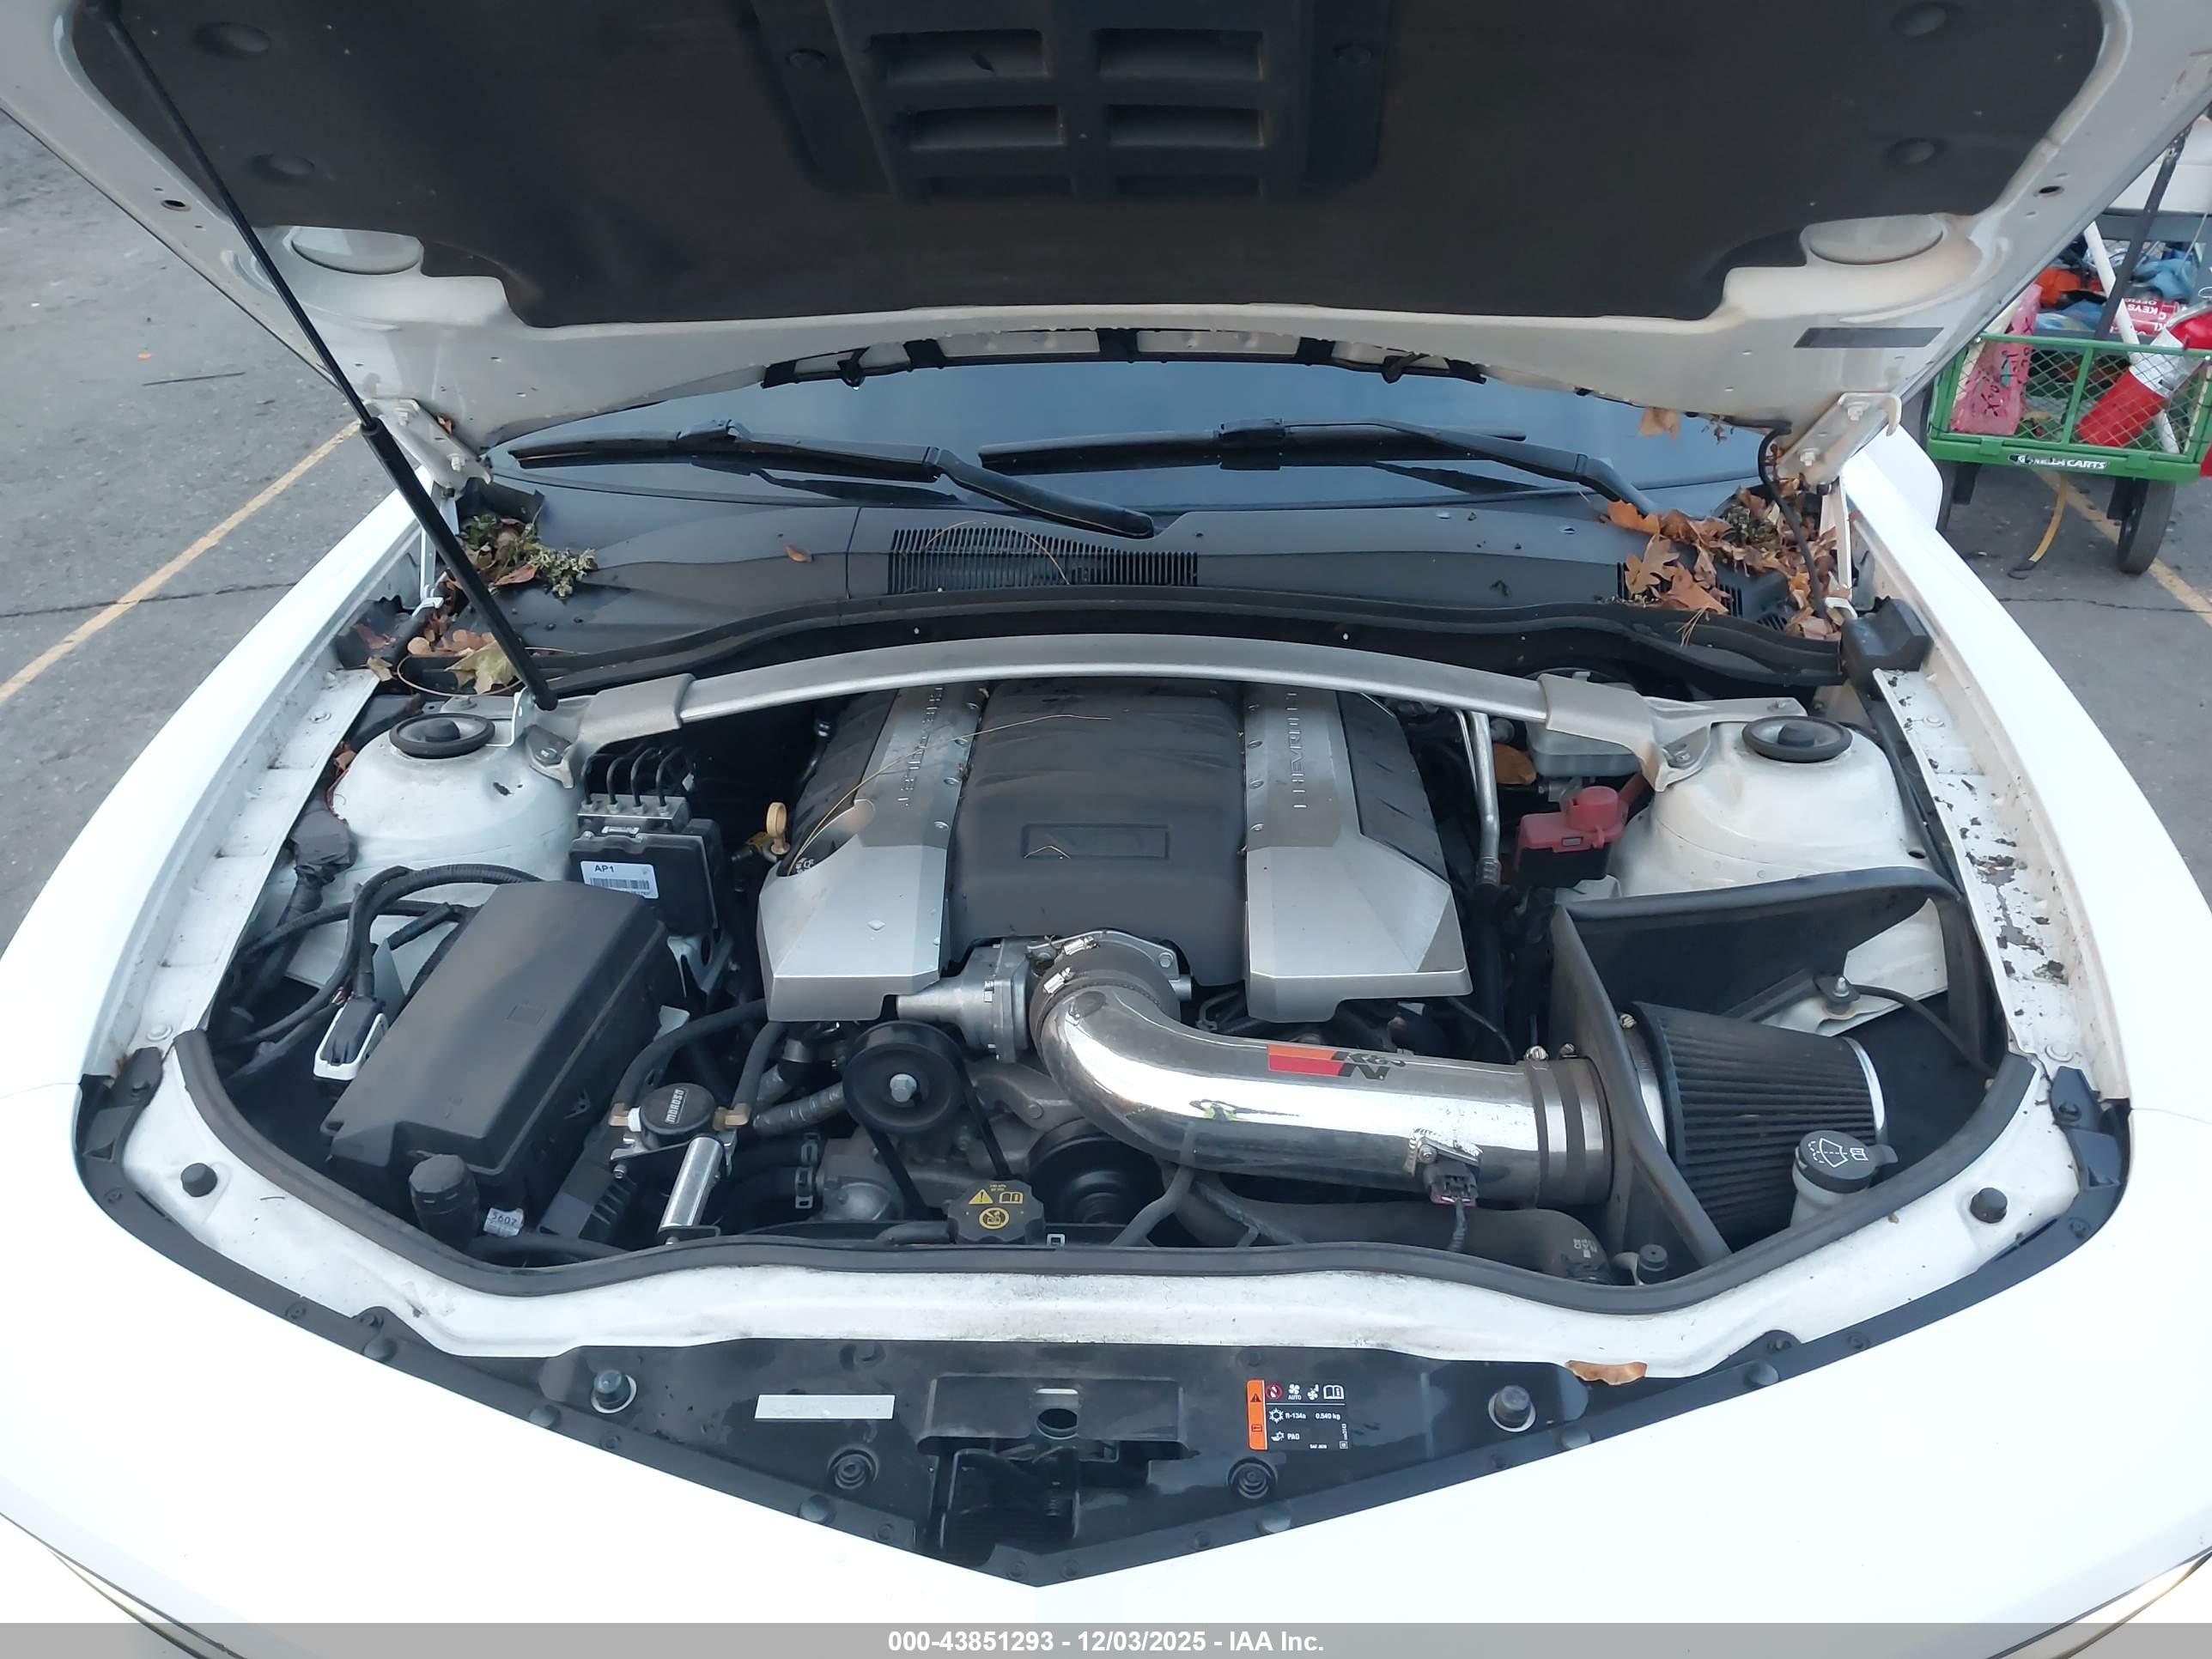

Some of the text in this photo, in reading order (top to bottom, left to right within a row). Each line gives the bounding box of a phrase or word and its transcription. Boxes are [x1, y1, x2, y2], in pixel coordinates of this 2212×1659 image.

[2127, 303, 2158, 315] KEYS
[2067, 459, 2107, 470] CARTS
[594, 865, 615, 873] AP1
[665, 1089, 685, 1123] MOROSO
